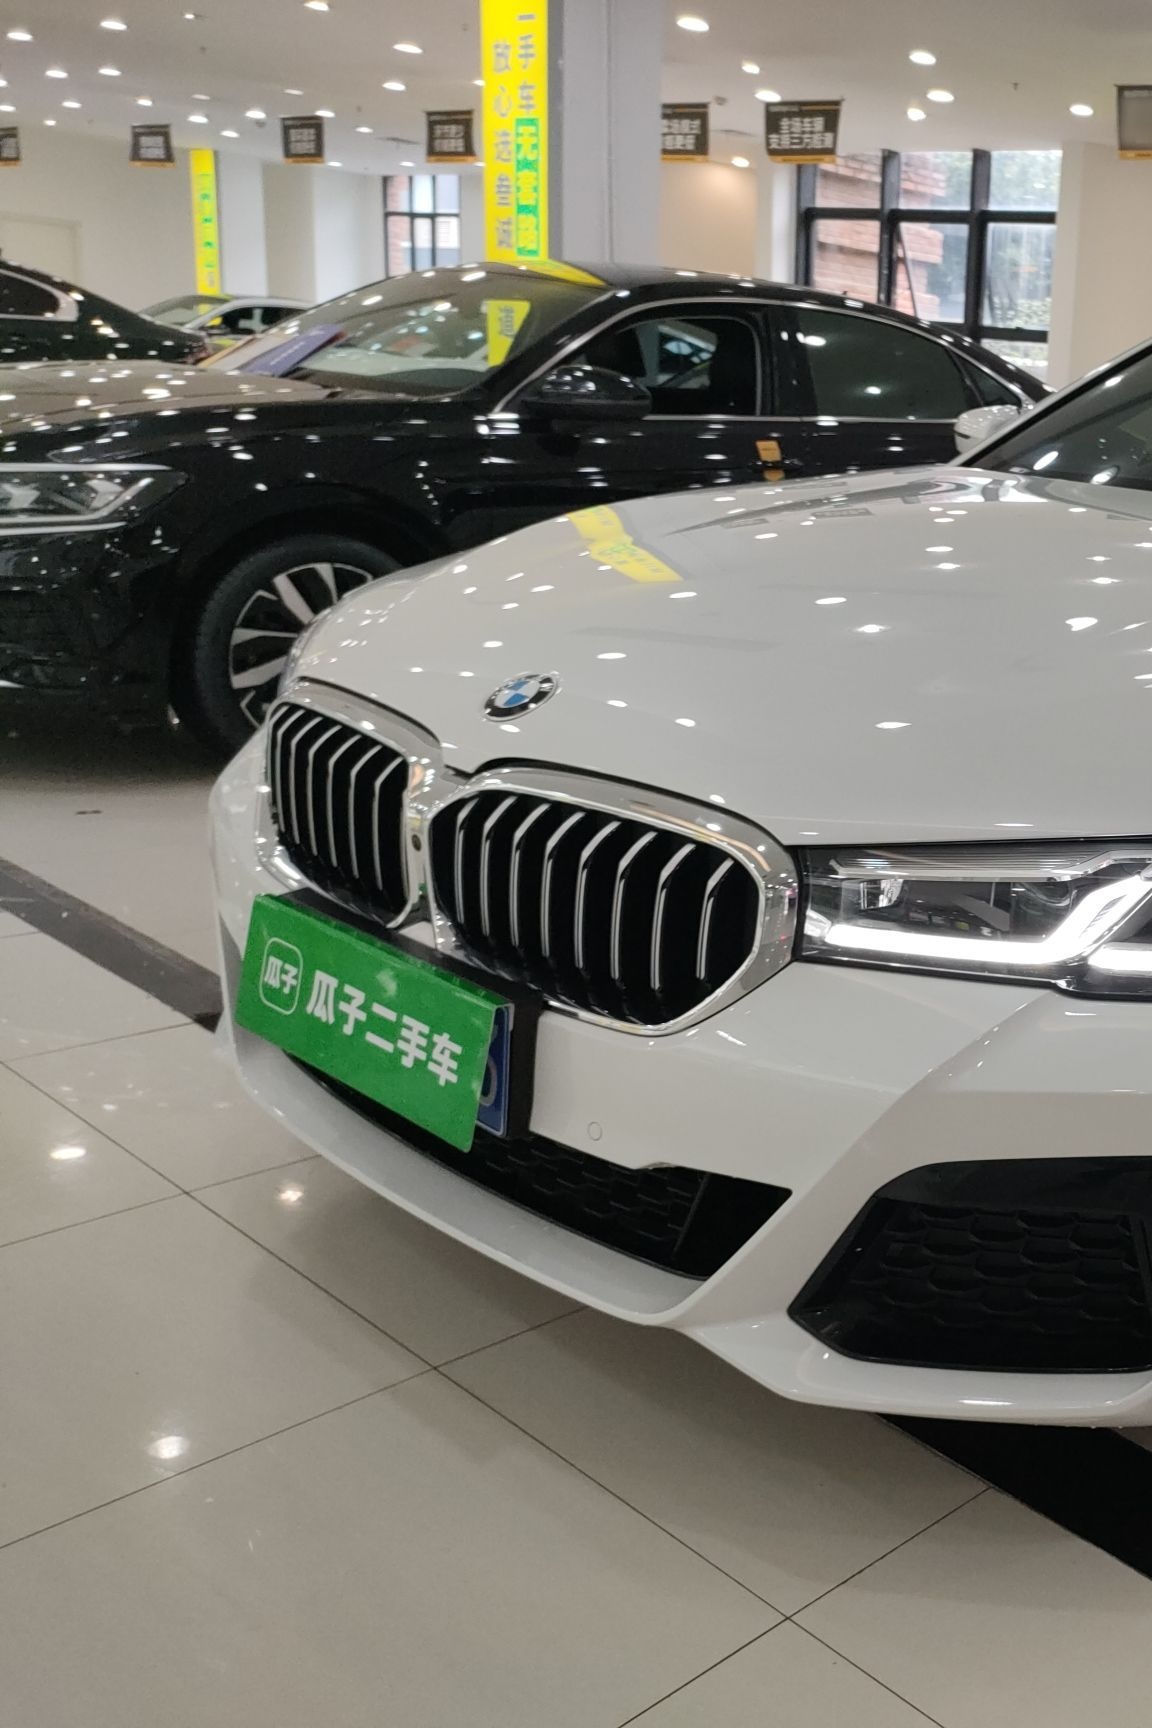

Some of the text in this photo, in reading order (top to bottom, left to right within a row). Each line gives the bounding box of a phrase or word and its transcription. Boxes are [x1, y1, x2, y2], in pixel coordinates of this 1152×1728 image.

[264, 958, 299, 994] 瓜子
[307, 971, 462, 1087] 瓜子二手车
